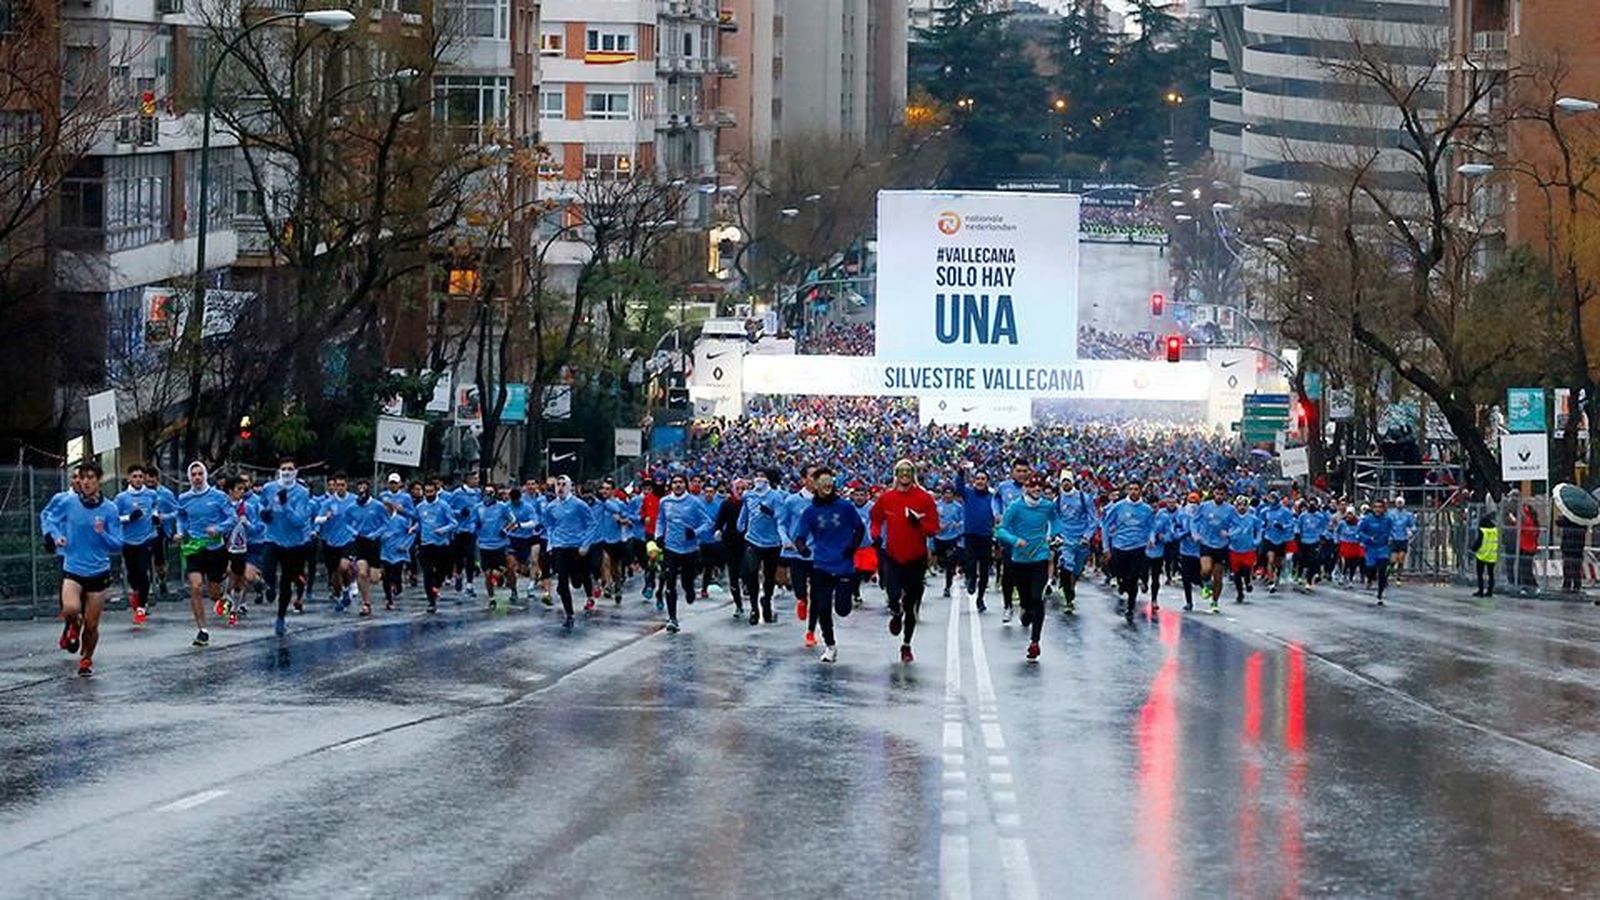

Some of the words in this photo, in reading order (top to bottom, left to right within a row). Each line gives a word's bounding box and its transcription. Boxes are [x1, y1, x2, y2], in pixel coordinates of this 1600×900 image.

[964, 214, 1003, 223] nationale
[964, 223, 1017, 232] nederlanden
[936, 247, 1016, 263] #VALLECANA
[936, 266, 977, 287] SOLO
[982, 267, 1016, 287] HAY
[935, 294, 1018, 345] UNA
[884, 366, 975, 390] SILVESTRE
[982, 368, 1084, 391] VALLECANA
